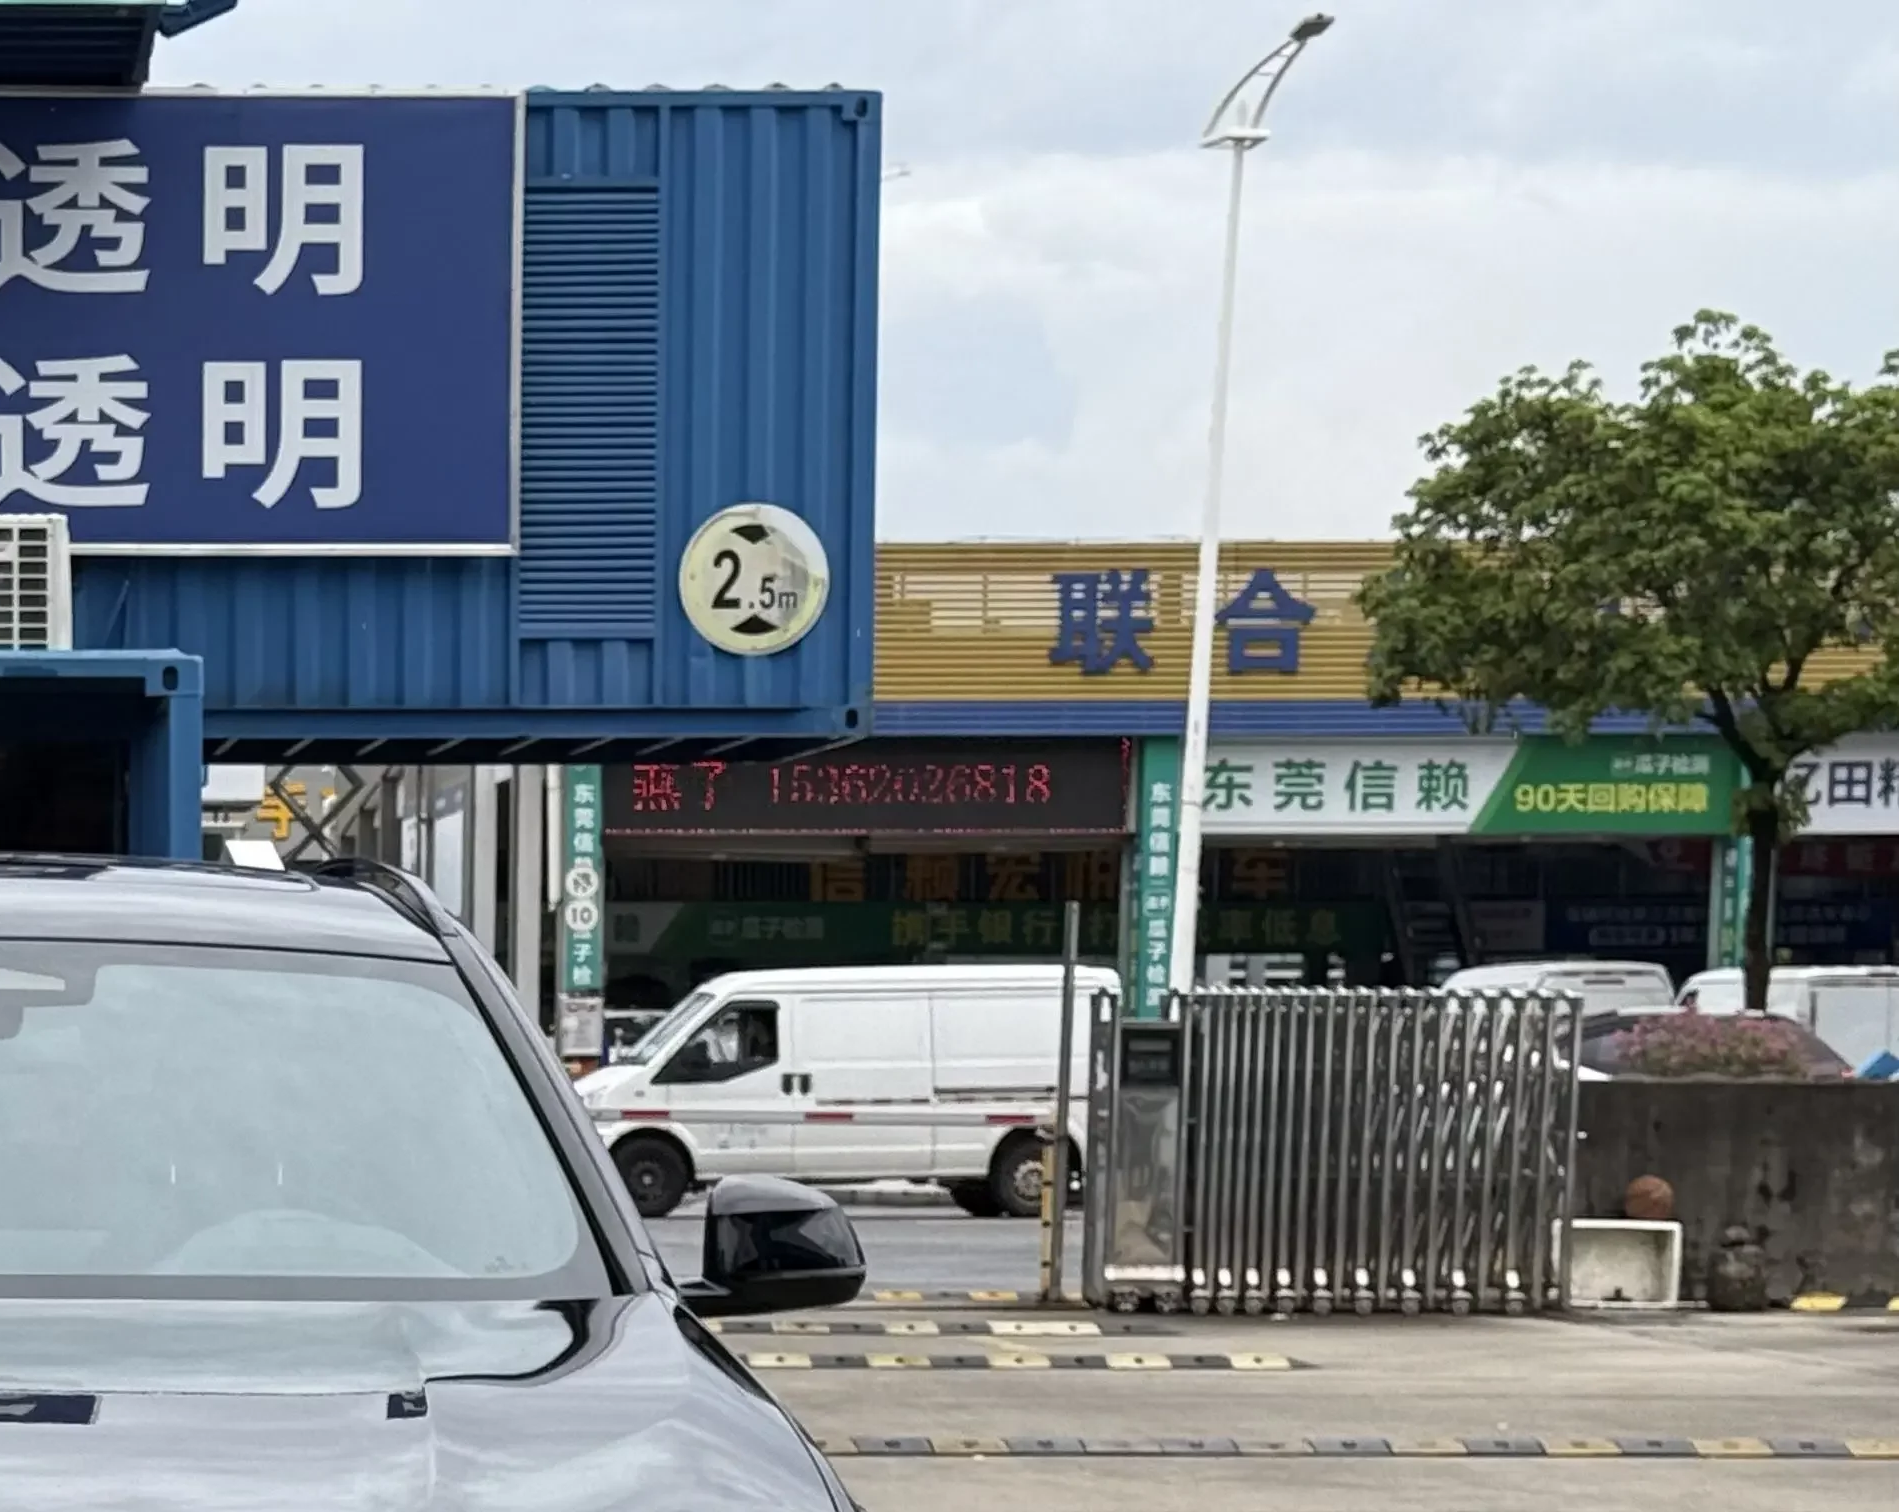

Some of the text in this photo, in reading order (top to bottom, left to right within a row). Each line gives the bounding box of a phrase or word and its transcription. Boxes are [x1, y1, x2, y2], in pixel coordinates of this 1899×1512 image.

[711, 549, 799, 611] 2.5m
[1202, 758, 1470, 812] 东莞信赖
[1513, 782, 1709, 814] 90天回购保障
[571, 906, 593, 924] 10
